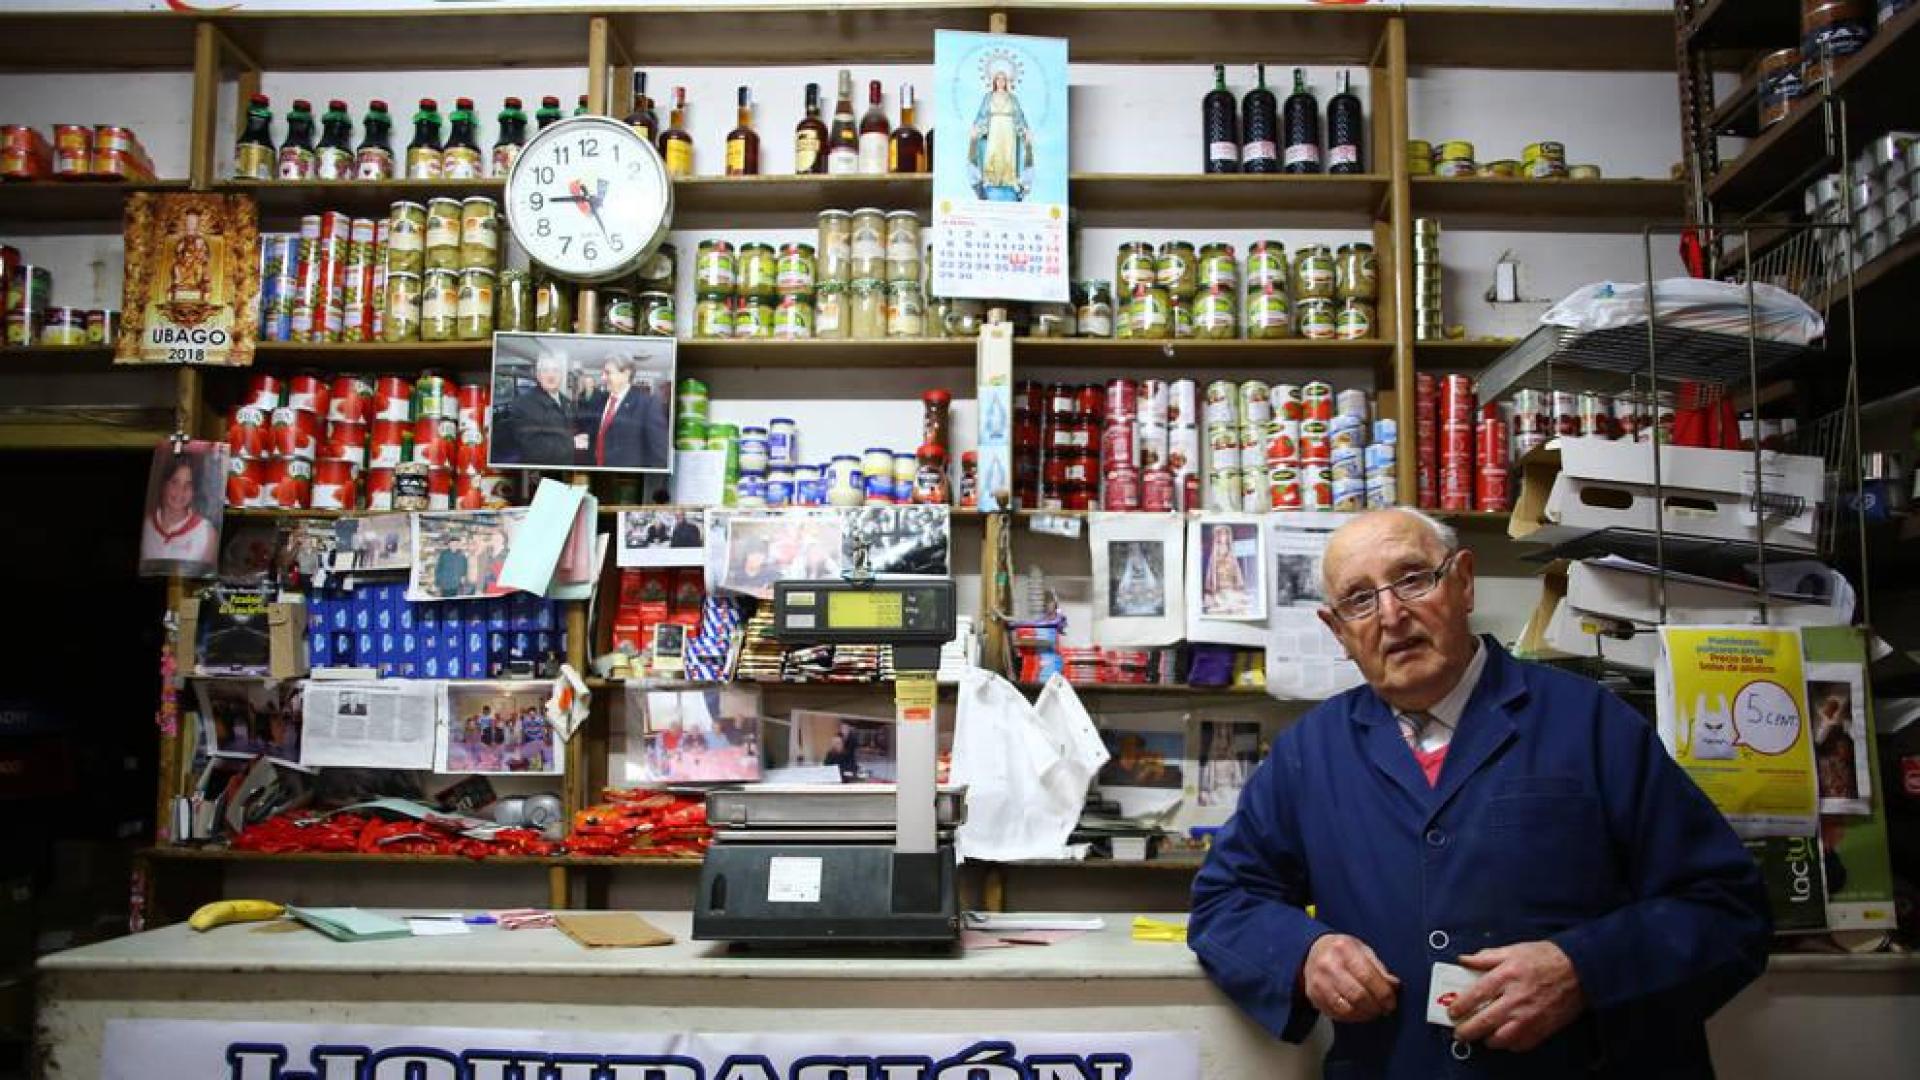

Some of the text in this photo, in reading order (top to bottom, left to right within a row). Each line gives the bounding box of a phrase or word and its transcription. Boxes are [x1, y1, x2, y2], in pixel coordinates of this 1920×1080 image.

[554, 146, 569, 165] 11
[577, 138, 599, 157] 12
[613, 144, 620, 162] 1
[530, 166, 555, 185] 10
[529, 191, 544, 211] 9
[536, 218, 551, 237] 8
[558, 235, 573, 255] 7
[583, 240, 598, 260] 6
[610, 233, 624, 252] 5
[152, 328, 226, 346] UBAGO
[168, 348, 205, 361] 2018
[1747, 693, 1763, 723] 5
